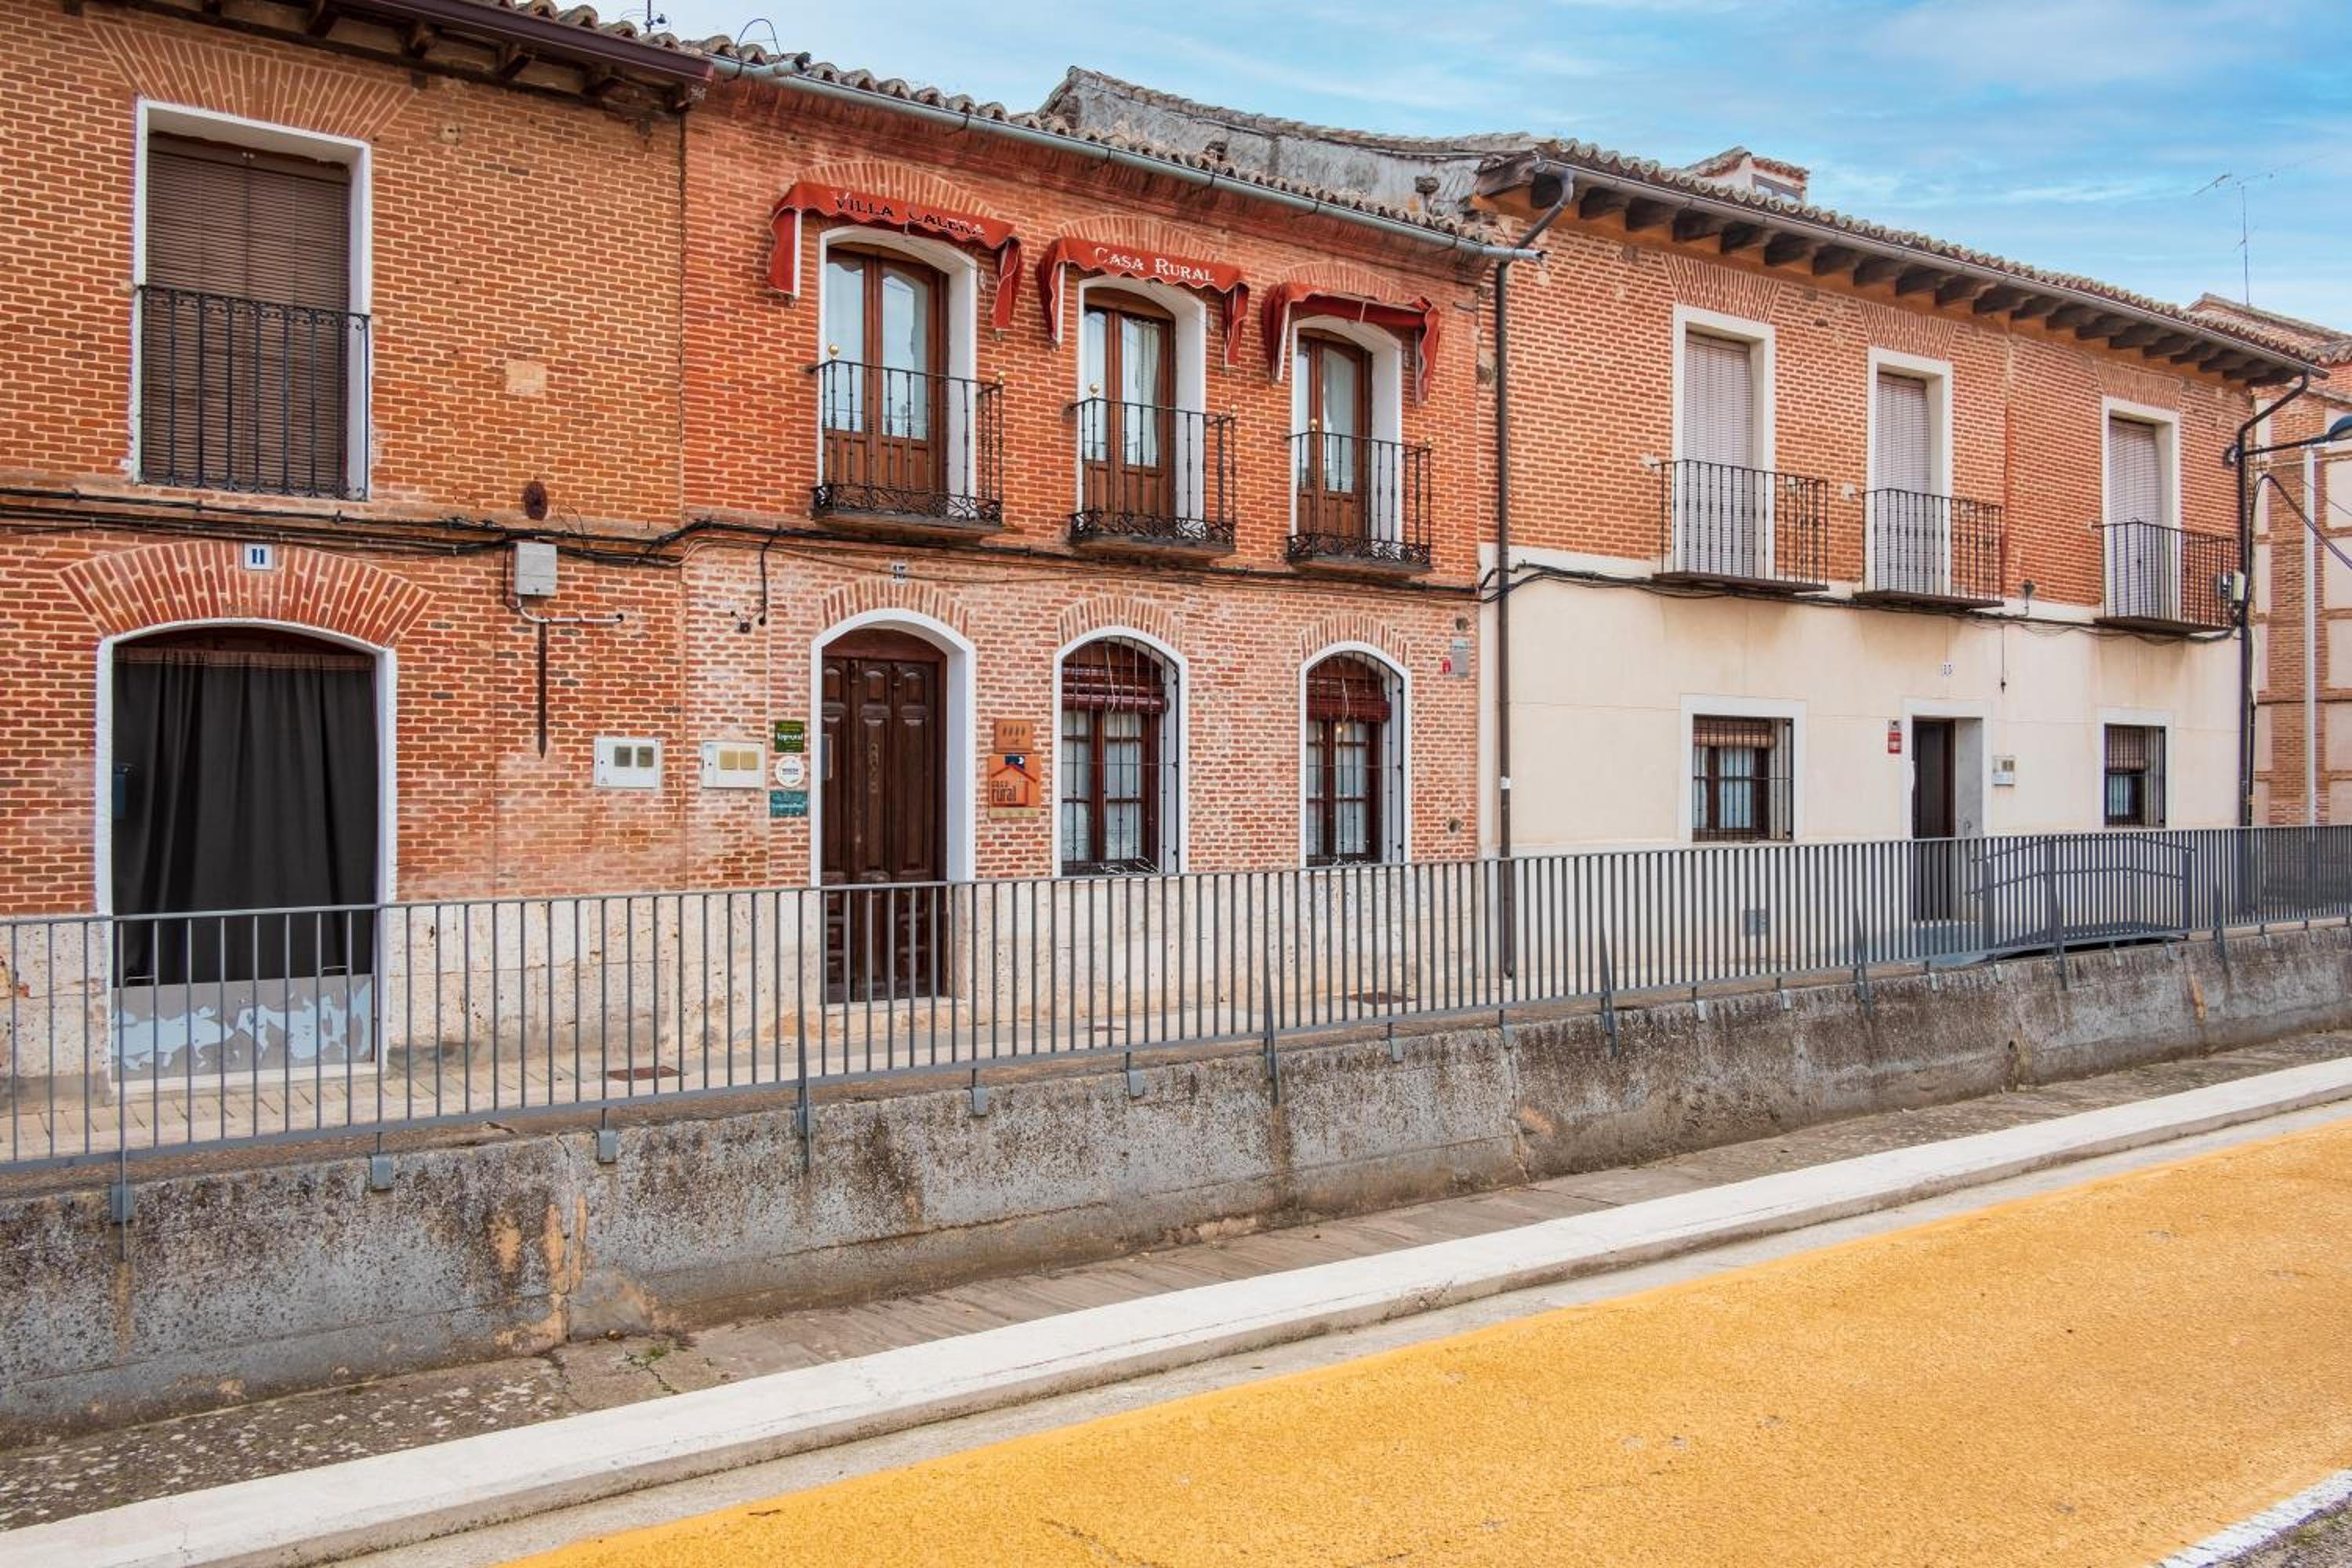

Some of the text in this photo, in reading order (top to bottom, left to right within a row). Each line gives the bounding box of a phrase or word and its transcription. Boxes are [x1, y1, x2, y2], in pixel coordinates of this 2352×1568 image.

[829, 191, 894, 216] VILLA
[252, 548, 265, 564] 11
[991, 785, 1017, 802] rural
